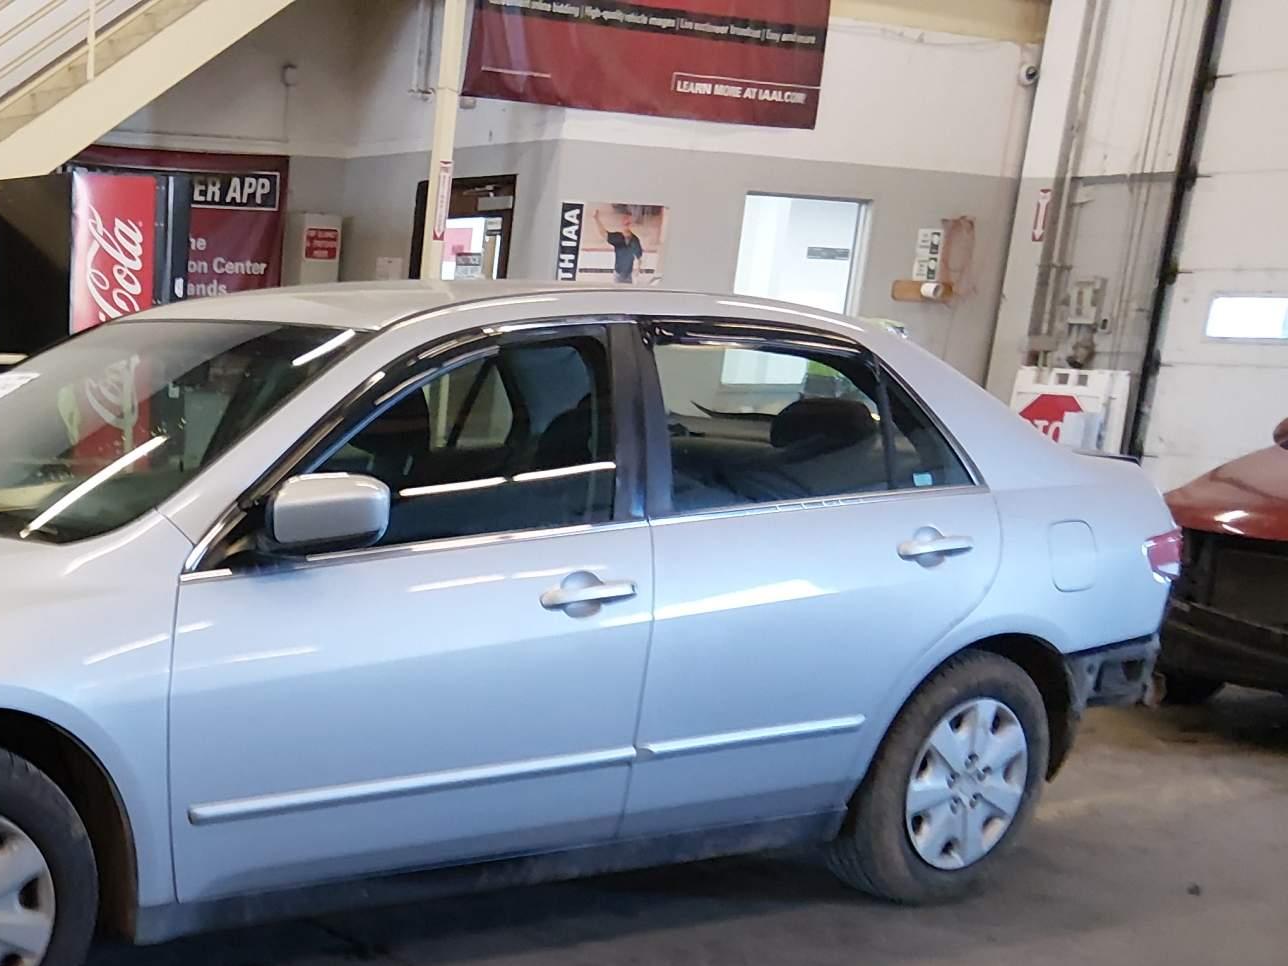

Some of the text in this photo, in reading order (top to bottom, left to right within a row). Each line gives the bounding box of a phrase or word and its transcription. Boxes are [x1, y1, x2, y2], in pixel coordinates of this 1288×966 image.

[676, 80, 711, 94] LEARN
[713, 84, 742, 98] MORE
[743, 87, 758, 99] AT
[193, 176, 271, 204] ER APP
[561, 208, 581, 247] IAA
[87, 204, 143, 319] Cola
[213, 257, 267, 274] Center
